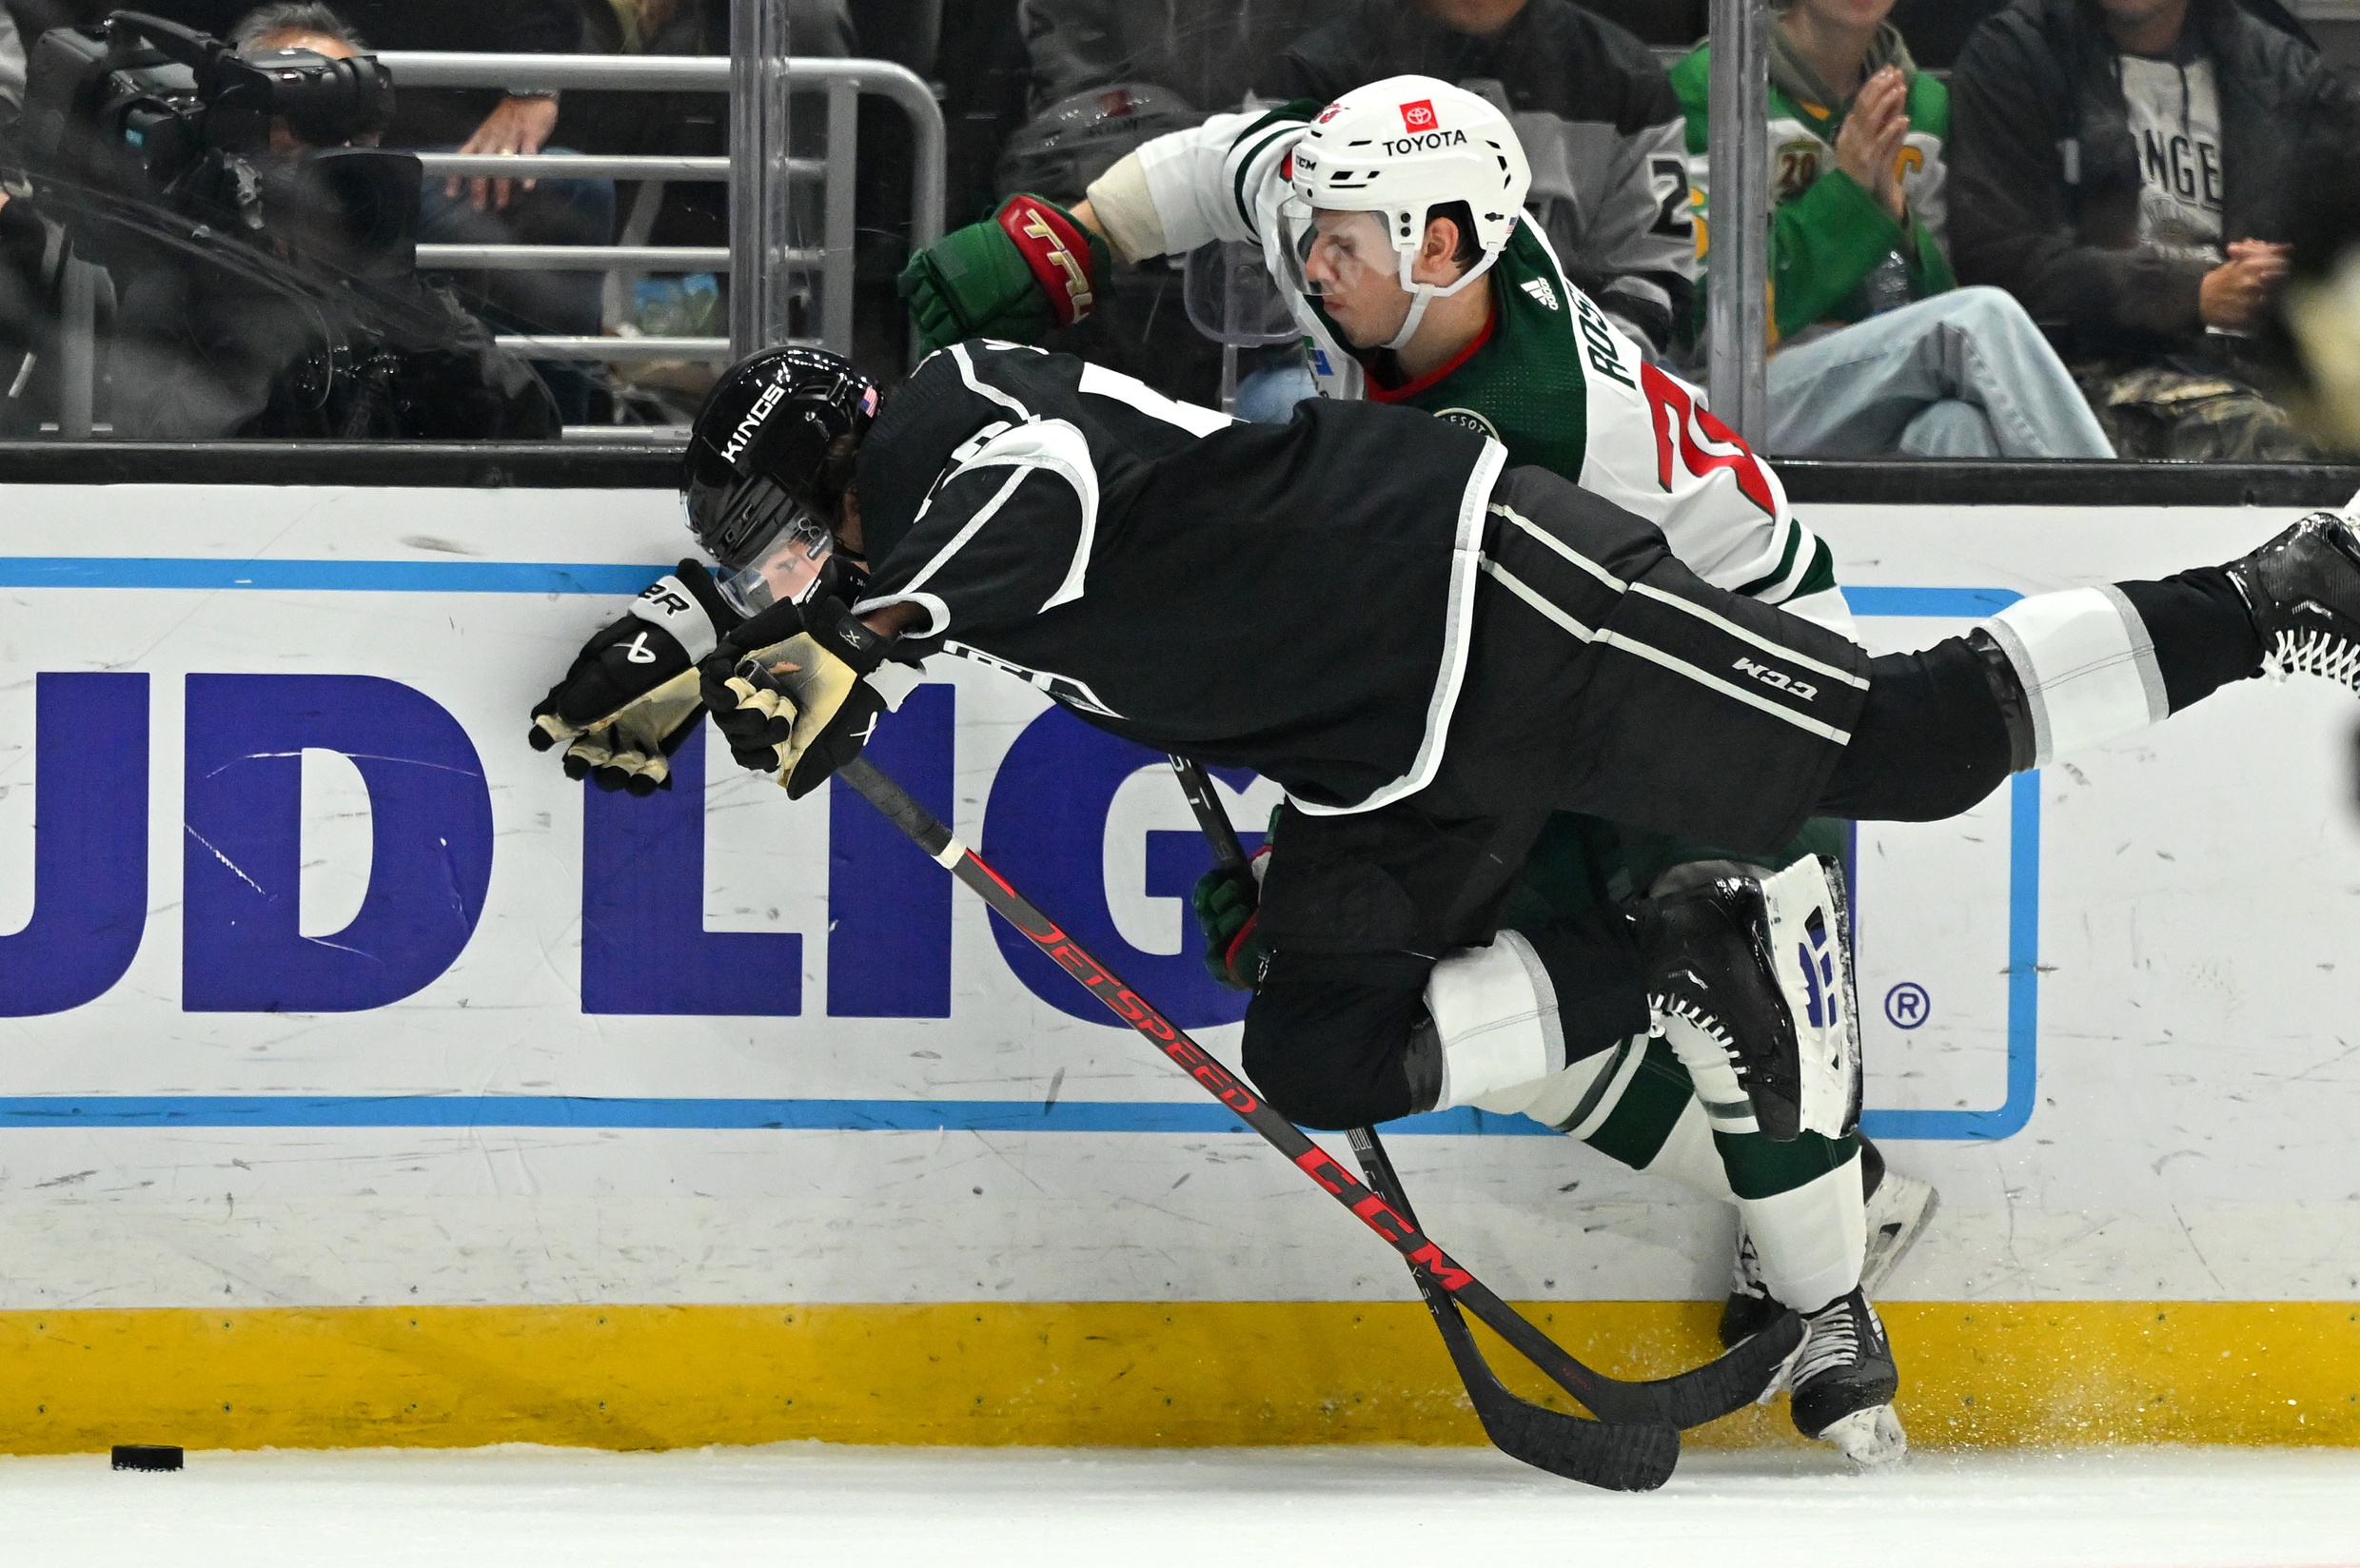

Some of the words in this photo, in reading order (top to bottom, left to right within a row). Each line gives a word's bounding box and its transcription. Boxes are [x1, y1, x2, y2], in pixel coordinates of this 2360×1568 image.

[1383, 129, 1467, 157] TOYOTA
[720, 383, 787, 464] KINGS
[1732, 657, 1819, 702] CCM
[581, 683, 1267, 1029] LIG
[1016, 921, 1257, 1113] JETSPEED
[1296, 1145, 1475, 1291] CCM
